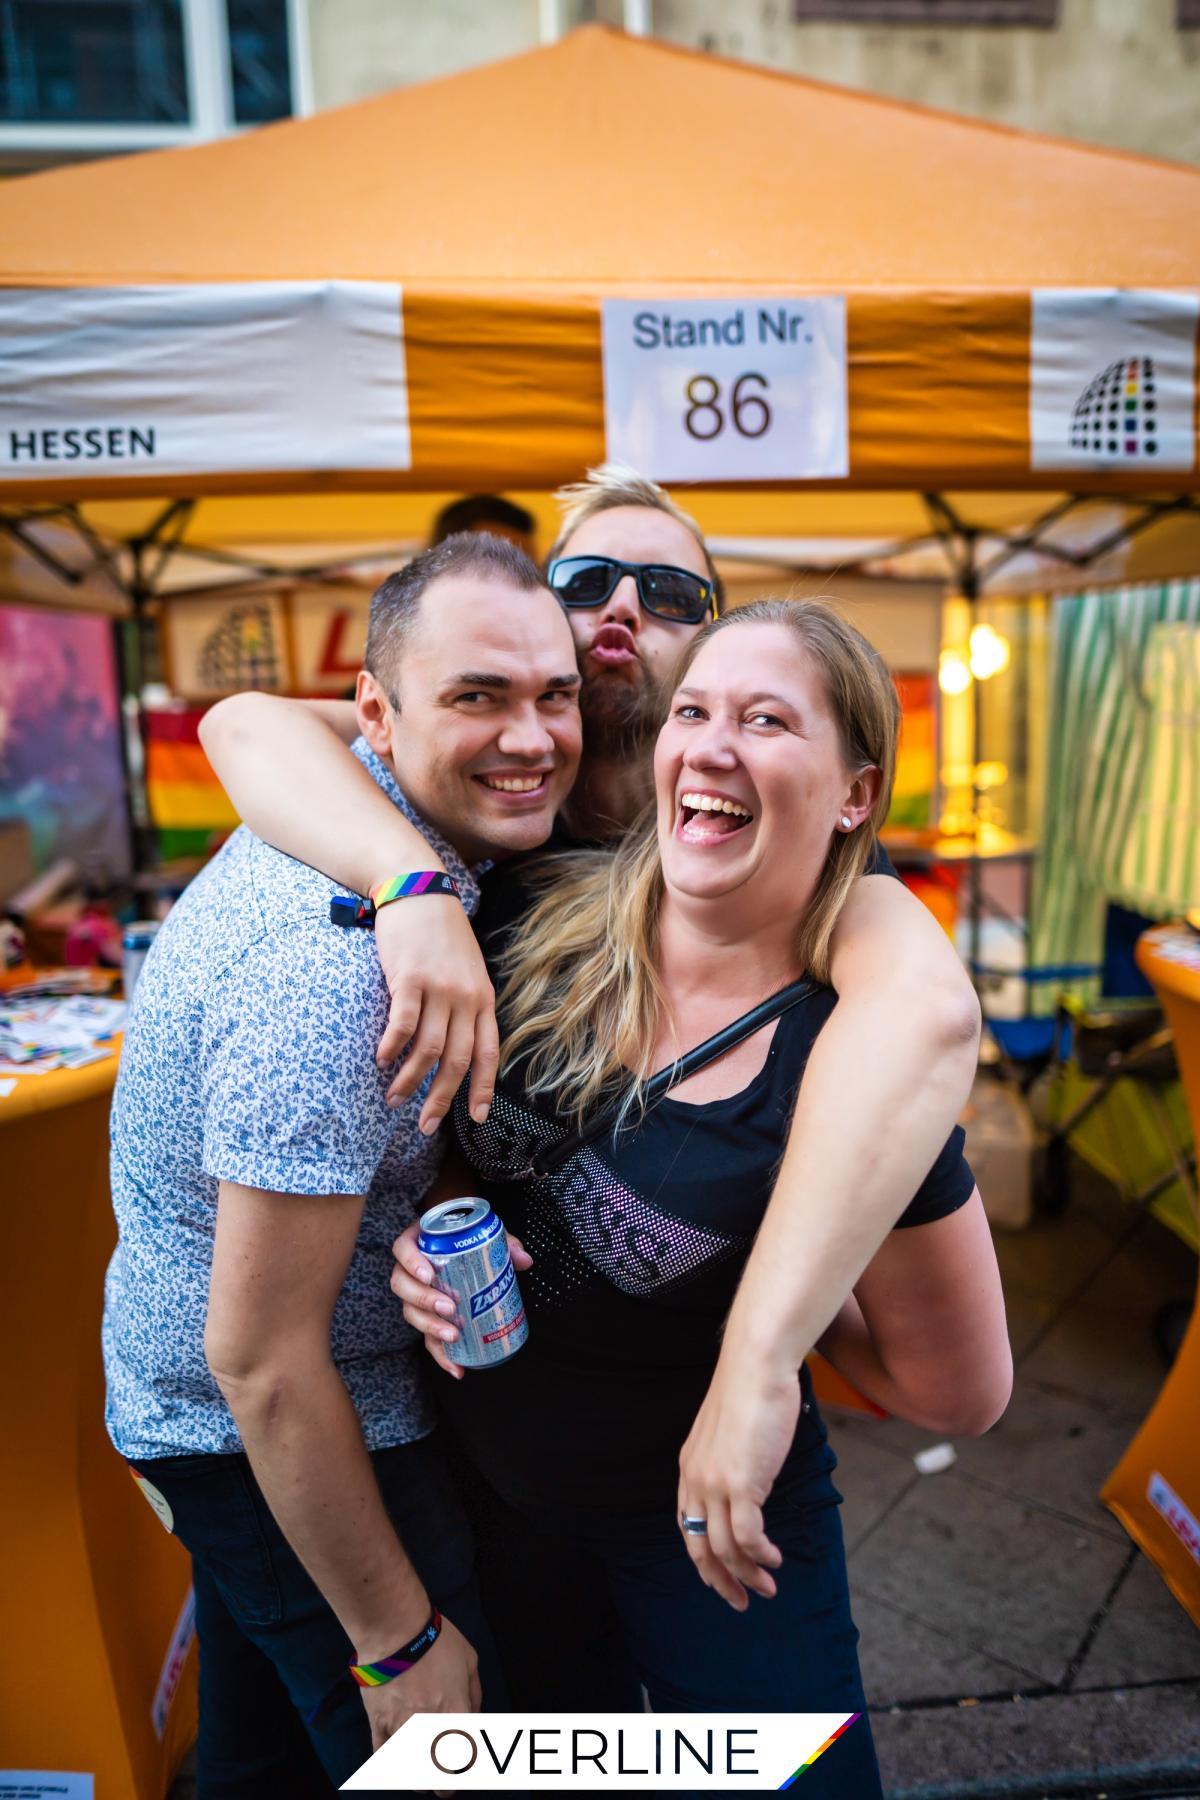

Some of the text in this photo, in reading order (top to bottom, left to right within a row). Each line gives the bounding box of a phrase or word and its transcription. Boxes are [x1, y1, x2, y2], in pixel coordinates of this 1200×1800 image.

[633, 308, 813, 349] Stand Nr.
[684, 371, 772, 441] 86
[10, 426, 155, 460] HESSEN
[453, 1236, 479, 1249] VODKA
